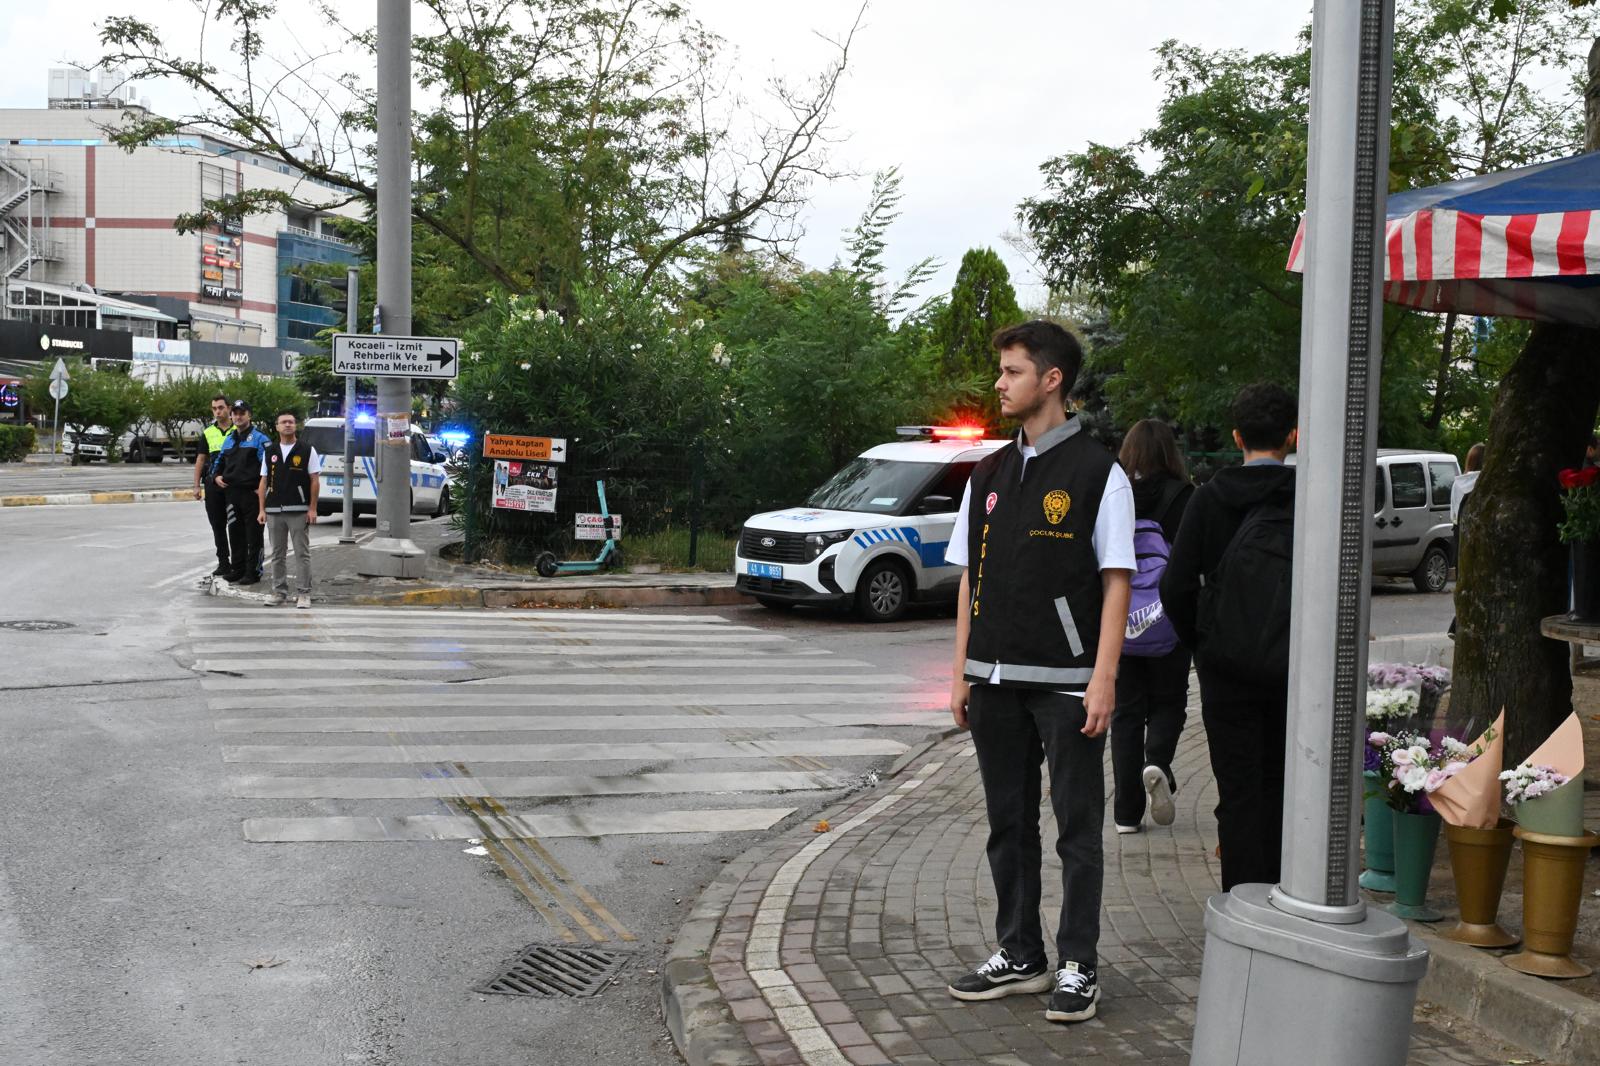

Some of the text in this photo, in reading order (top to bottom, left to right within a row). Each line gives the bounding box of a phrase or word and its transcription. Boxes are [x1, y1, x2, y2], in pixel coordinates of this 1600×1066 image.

[348, 341, 385, 349] Kocaeli
[397, 340, 423, 351] İzmit
[229, 352, 249, 364] MADO
[354, 351, 401, 360] Rehberlik
[338, 361, 433, 372] Araştırma Merkezi
[490, 437, 544, 448] Yahya Kaptan
[489, 447, 547, 457] Anadolu Lisesi
[760, 564, 766, 574] A
[1127, 599, 1165, 636] NIKE
